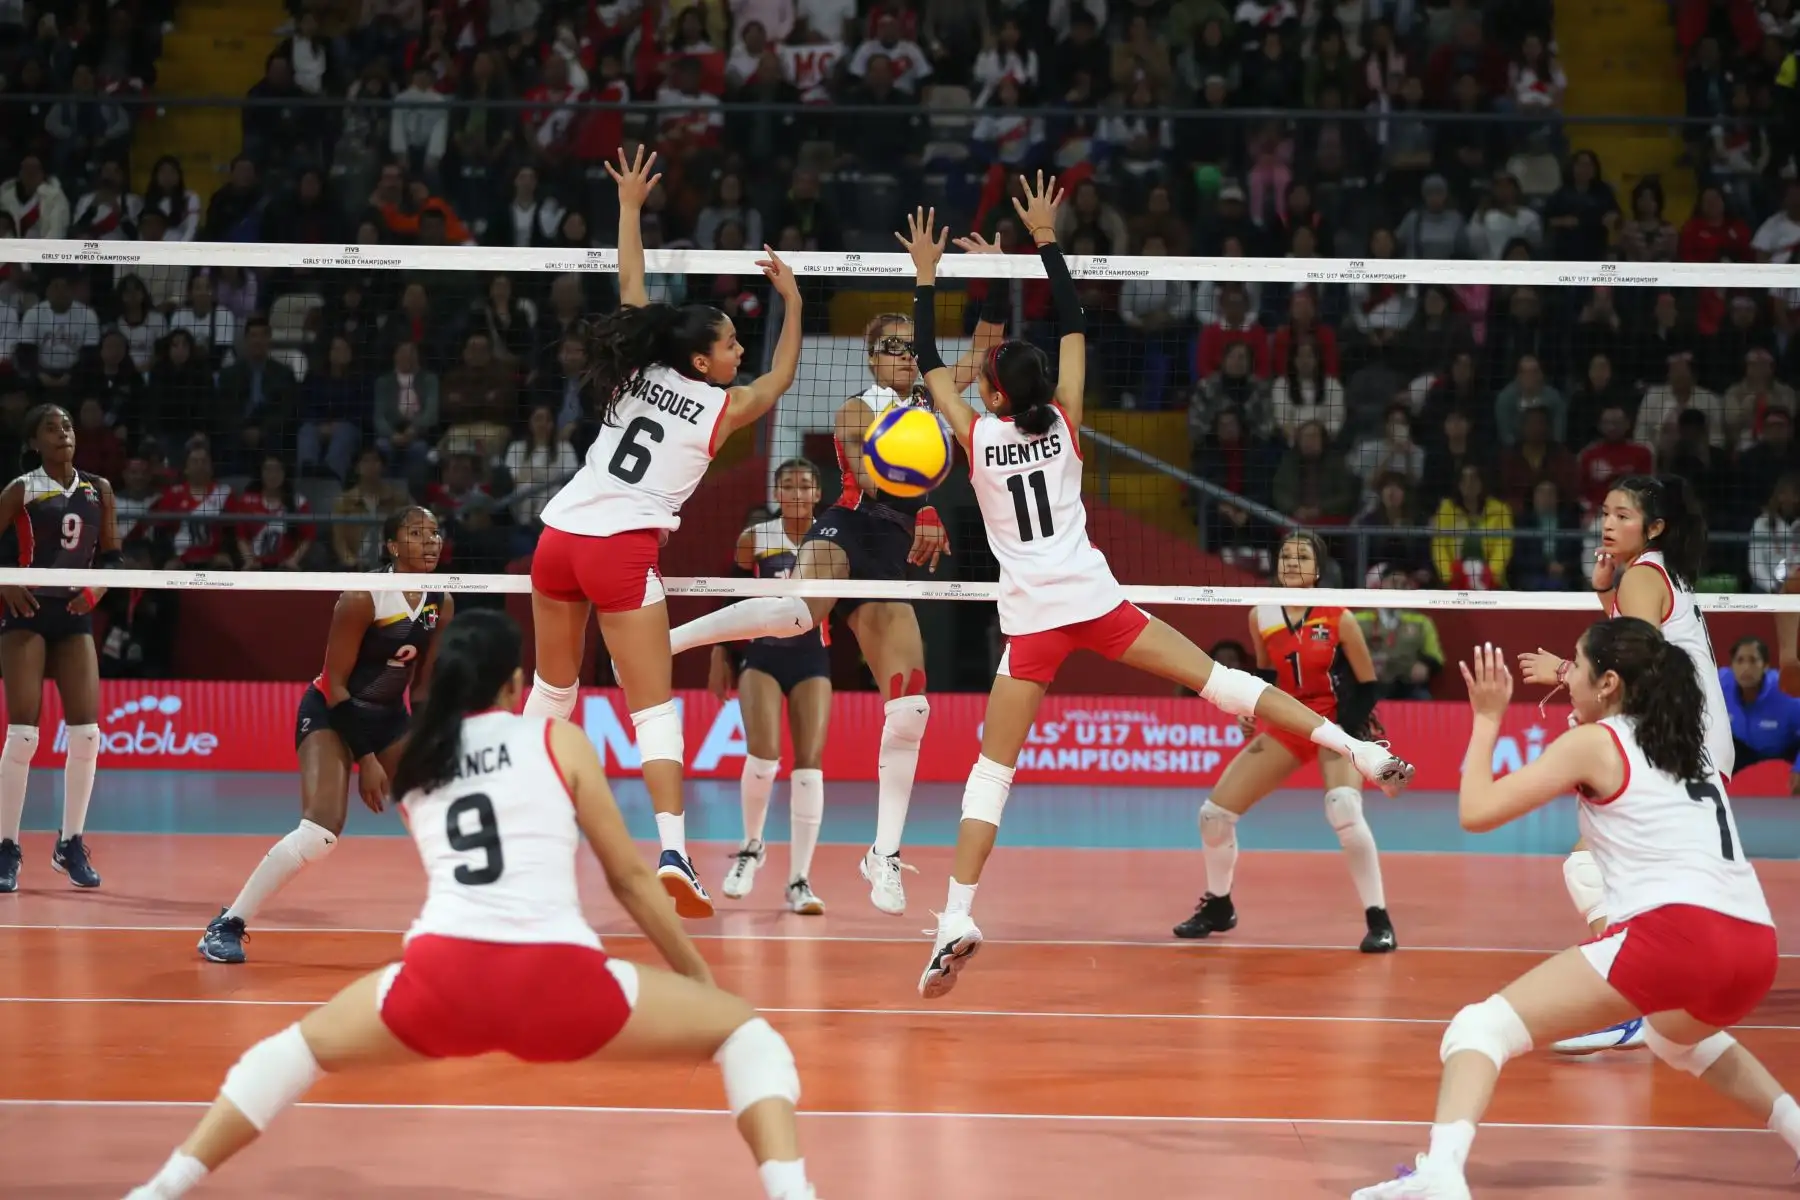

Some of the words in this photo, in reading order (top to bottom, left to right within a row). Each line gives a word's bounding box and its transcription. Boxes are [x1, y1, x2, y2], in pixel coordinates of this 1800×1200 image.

[96, 254, 141, 262] CHAMPIONSHIP
[627, 377, 705, 426] VASQUEZ
[607, 415, 665, 485] 6
[984, 433, 1062, 468] FUENTES
[1006, 469, 1055, 543] 11
[60, 512, 82, 551] 9
[386, 644, 418, 668] 2
[1284, 651, 1302, 689] 1
[301, 717, 312, 733] 2
[1063, 709, 1160, 724] VOLLEYBALL
[1074, 723, 1130, 745] U17
[1142, 724, 1245, 747] WORLD
[52, 719, 219, 756] liablue
[1017, 747, 1221, 773] HAMPIONSHIP
[446, 792, 505, 886] 9
[1685, 781, 1735, 861] 7
